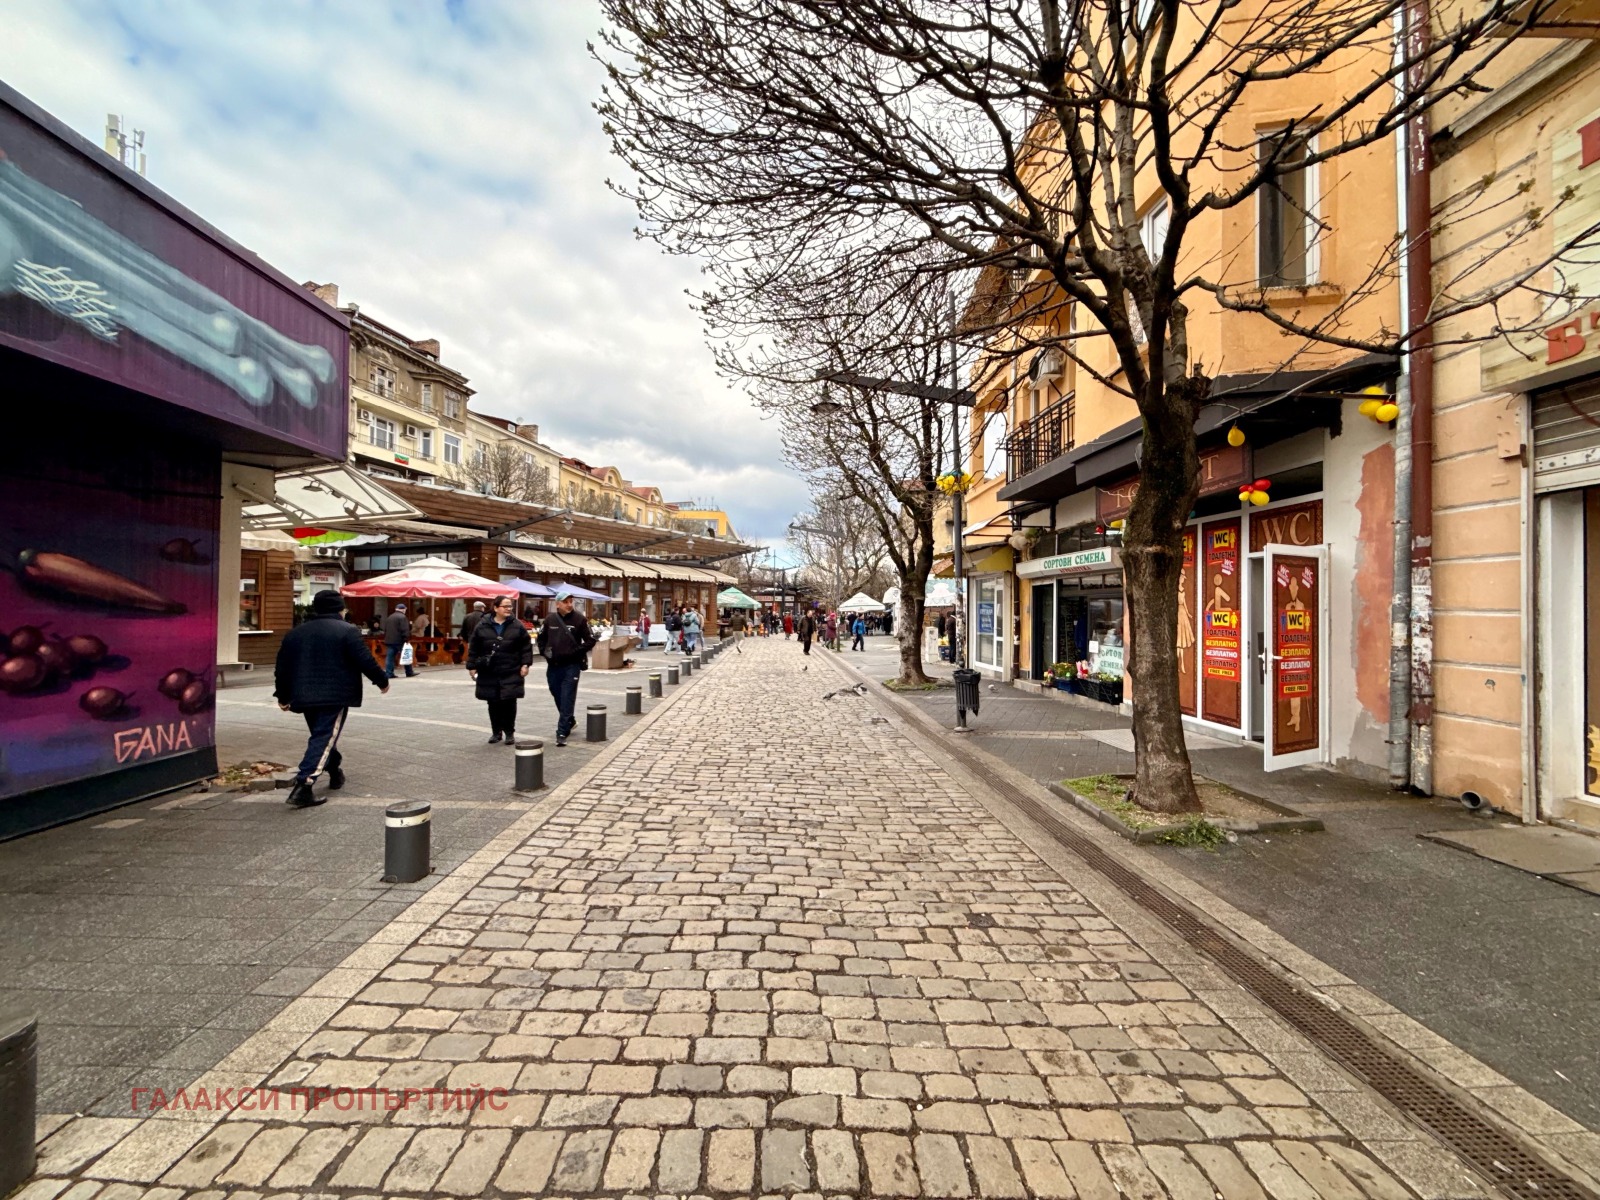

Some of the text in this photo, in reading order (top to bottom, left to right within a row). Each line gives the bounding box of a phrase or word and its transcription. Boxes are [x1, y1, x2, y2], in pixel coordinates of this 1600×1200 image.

[1261, 511, 1310, 545] WC
[1214, 532, 1228, 544] WC
[1075, 551, 1106, 565] СЕМЕНА
[1208, 552, 1236, 561] ТОАЛЕТНА
[1213, 613, 1228, 624] WC
[1288, 613, 1302, 626] WC
[1206, 629, 1237, 637] ТОАЛЕТНА
[1280, 634, 1310, 642] ТОАЛЕТНА
[1206, 639, 1237, 648] БЕЗПЛАТНО
[1206, 649, 1237, 659] БЕЗПЛАТНО
[1280, 648, 1310, 656] БЕЗПЛАТНО
[1206, 660, 1237, 668] БЕЗПЛАТНО
[1280, 661, 1310, 669] БЕЗПЛАТНО
